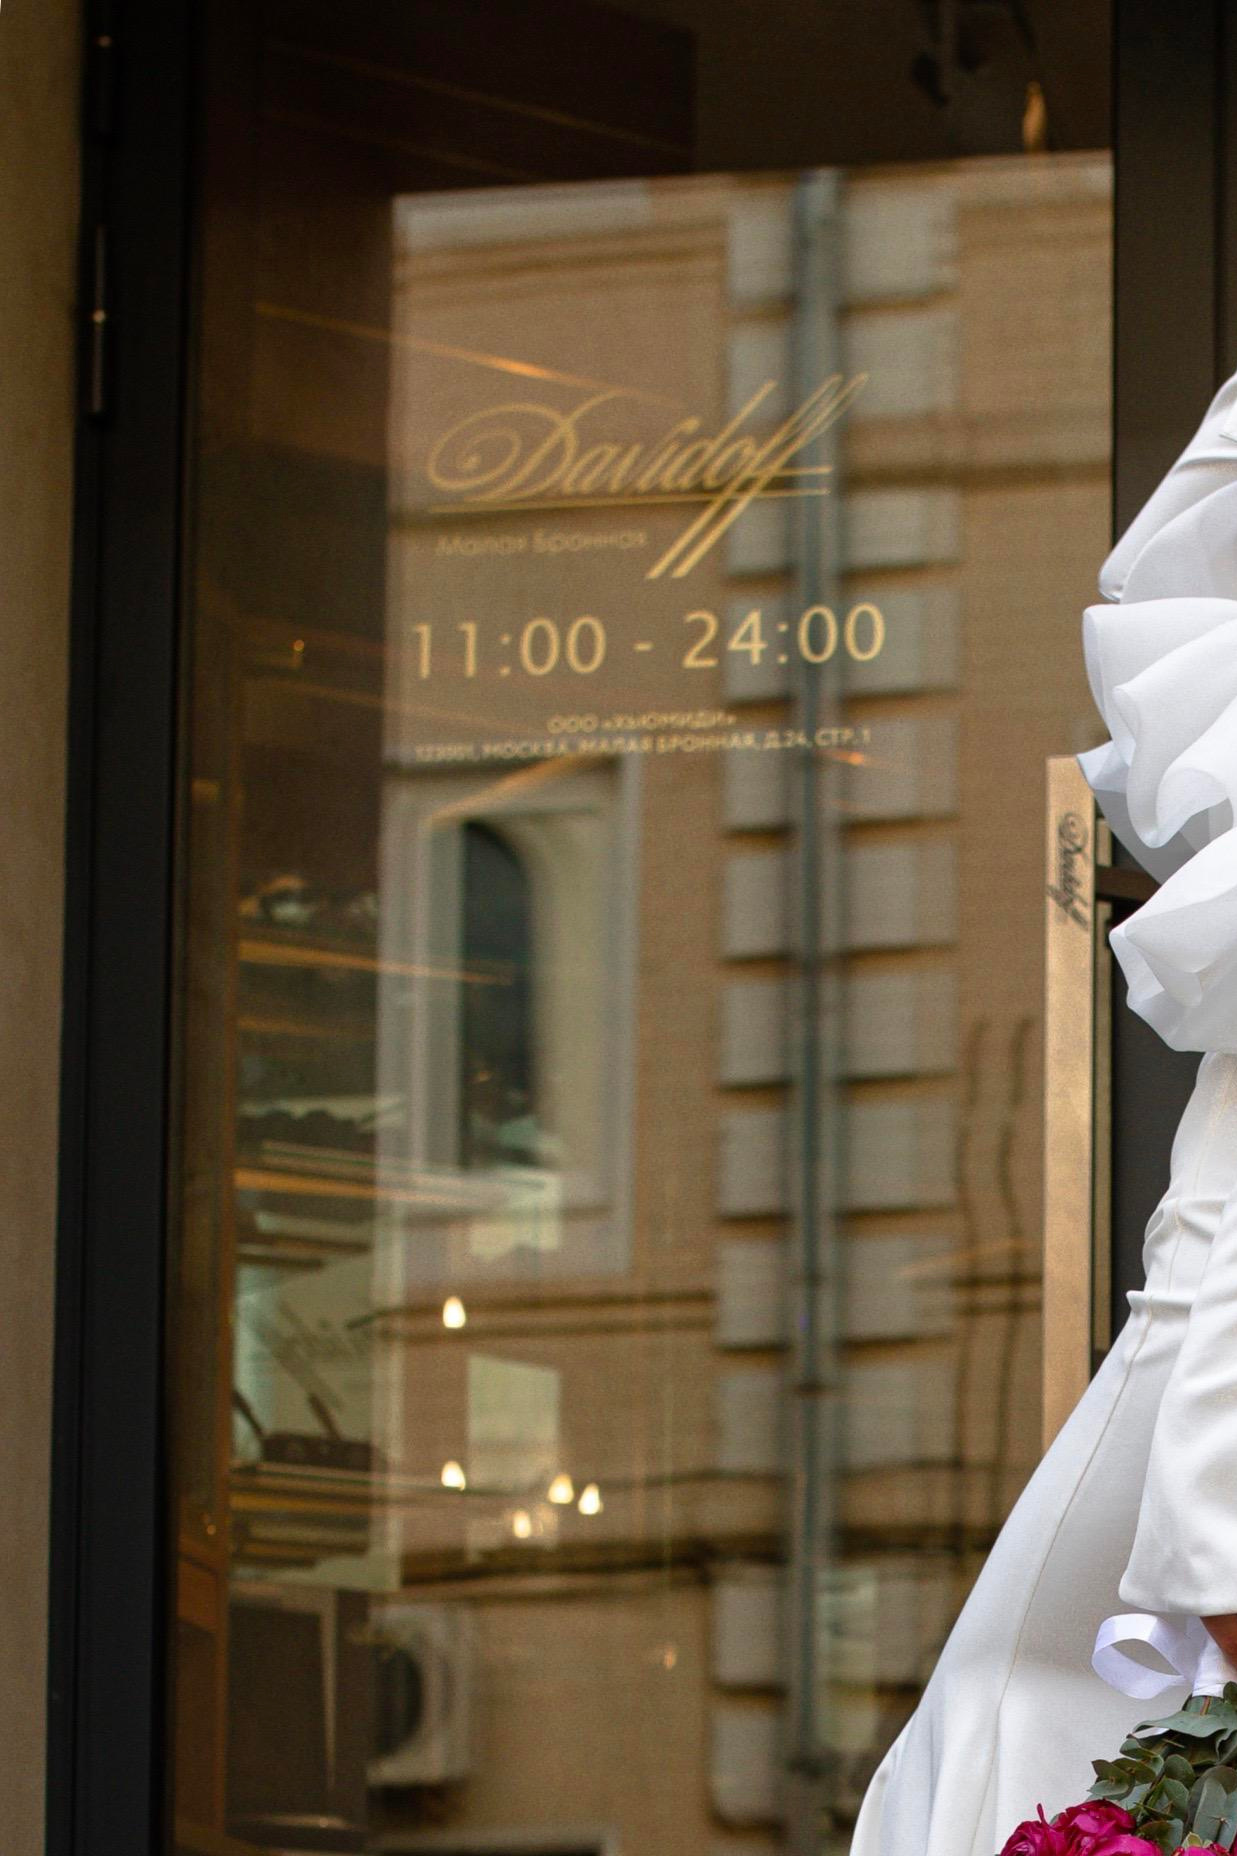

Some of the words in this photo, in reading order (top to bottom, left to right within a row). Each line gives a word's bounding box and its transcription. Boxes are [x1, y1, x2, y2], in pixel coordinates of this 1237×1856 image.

[428, 372, 867, 579] Davidoff
[413, 616, 607, 678] 11:00
[683, 603, 885, 668] 24:00
